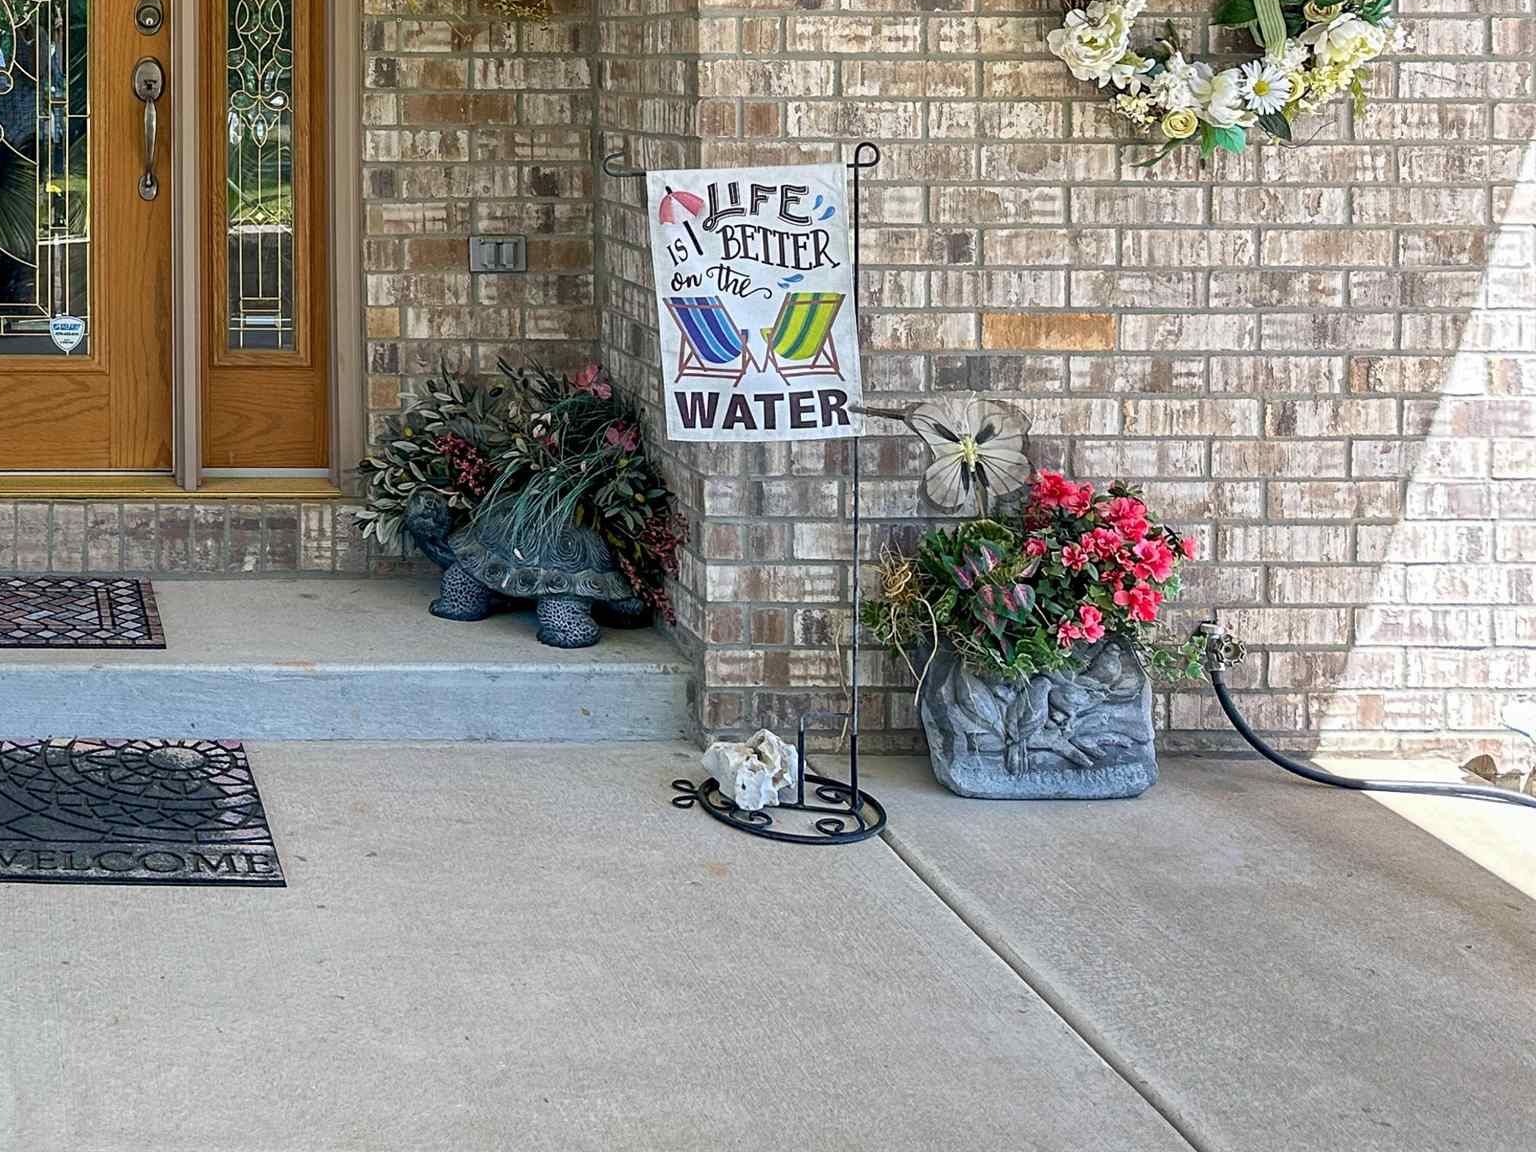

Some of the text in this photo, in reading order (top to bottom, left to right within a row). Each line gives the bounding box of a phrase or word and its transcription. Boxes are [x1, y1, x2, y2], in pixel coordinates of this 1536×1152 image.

[702, 181, 812, 232] LIFE
[666, 224, 840, 271] IS BETTER
[670, 263, 773, 299] on the
[674, 388, 851, 431] WATER
